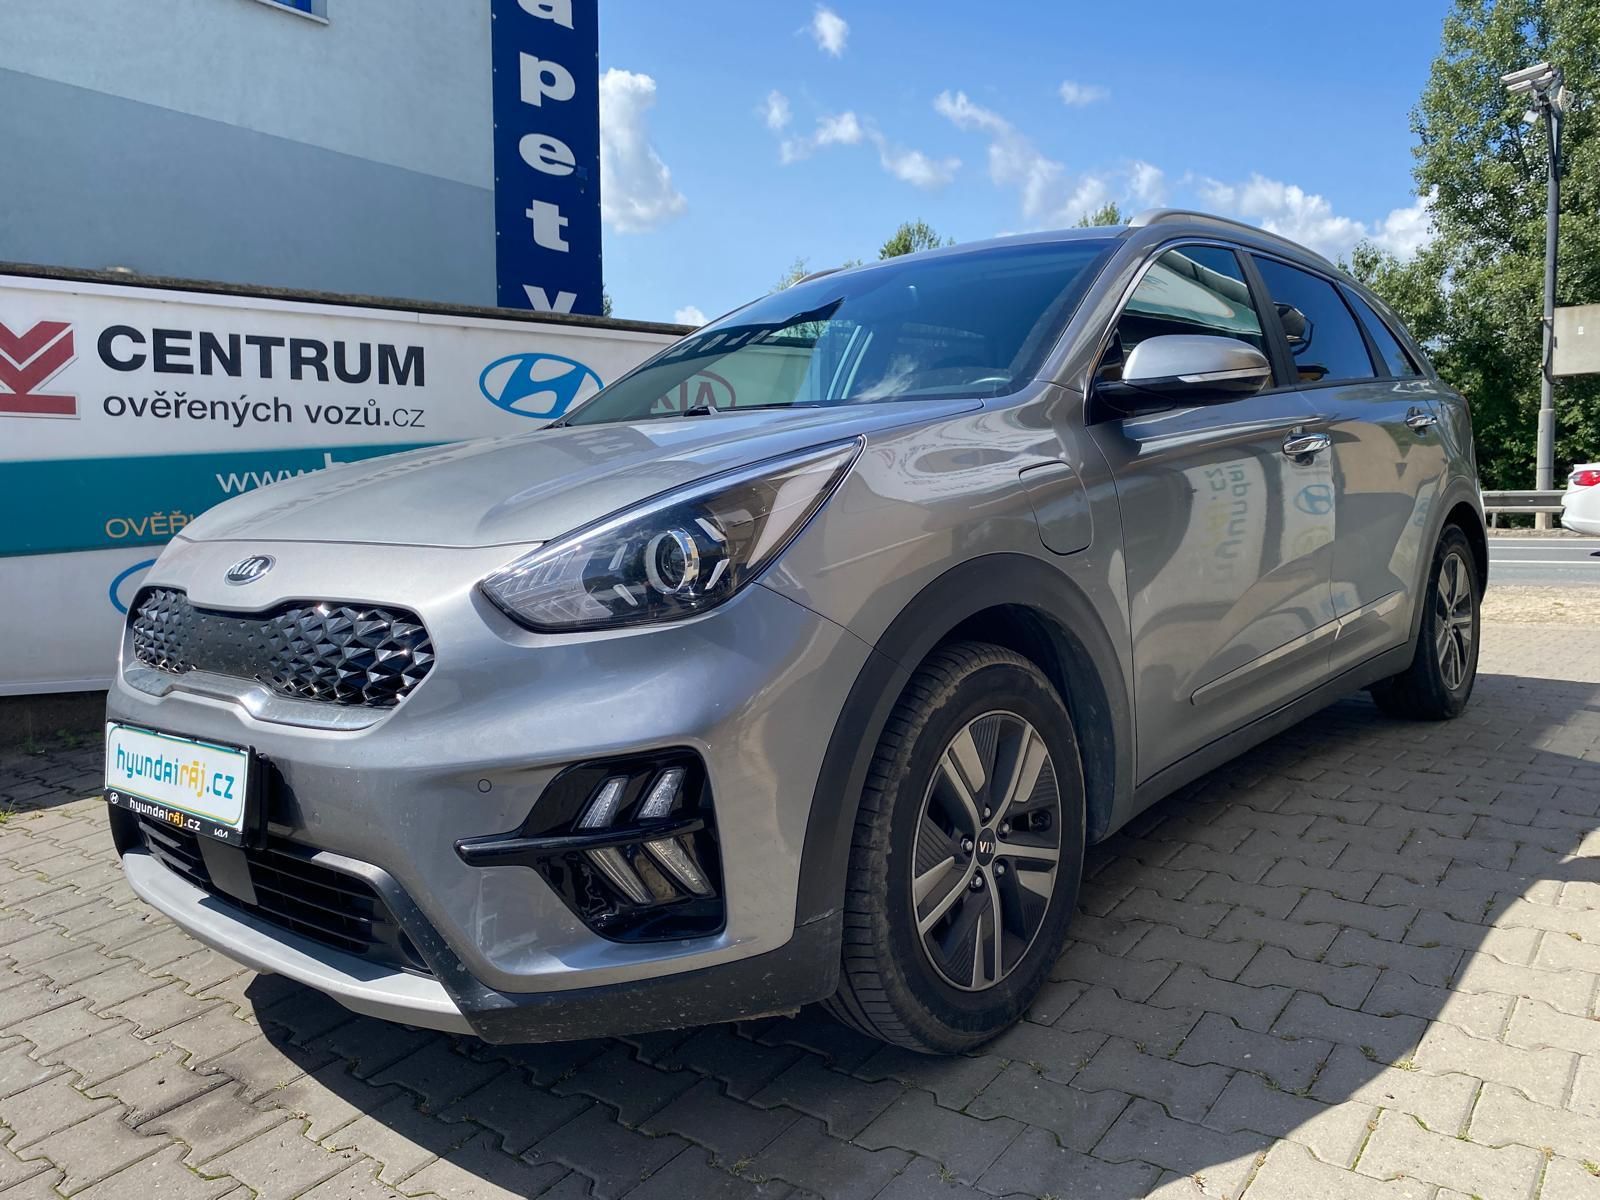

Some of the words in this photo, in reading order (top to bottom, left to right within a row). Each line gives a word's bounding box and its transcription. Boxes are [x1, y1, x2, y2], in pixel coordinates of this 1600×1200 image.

[97, 325, 425, 387] CENTRUM
[103, 390, 292, 428] ověřených
[304, 399, 426, 428] vozů.cz
[105, 510, 194, 539] OVĚŘ
